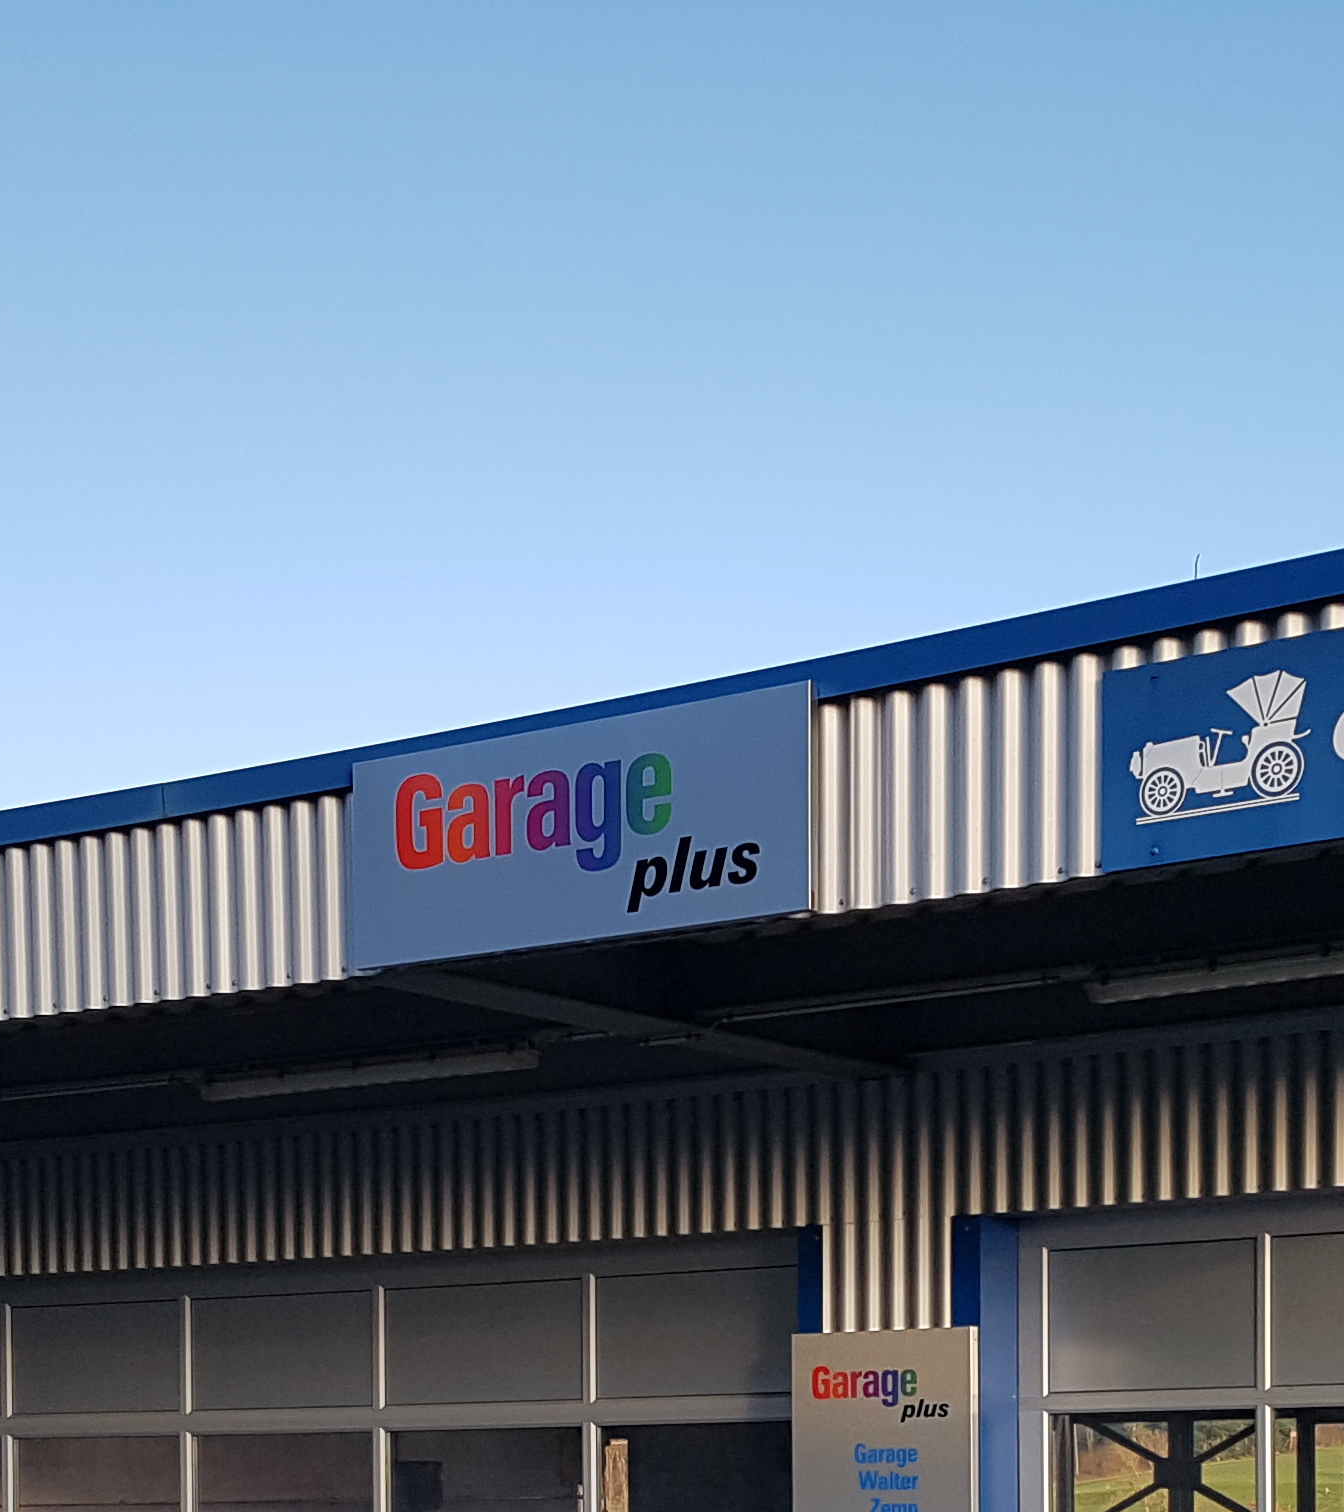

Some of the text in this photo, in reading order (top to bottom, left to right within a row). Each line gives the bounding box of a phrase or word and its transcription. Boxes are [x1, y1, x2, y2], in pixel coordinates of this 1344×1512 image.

[394, 752, 673, 873] Garage
[626, 835, 761, 913] plus
[811, 1365, 918, 1407] Garage
[900, 1399, 949, 1423] plus
[854, 1442, 918, 1468] Garage
[858, 1470, 919, 1490] Walter
